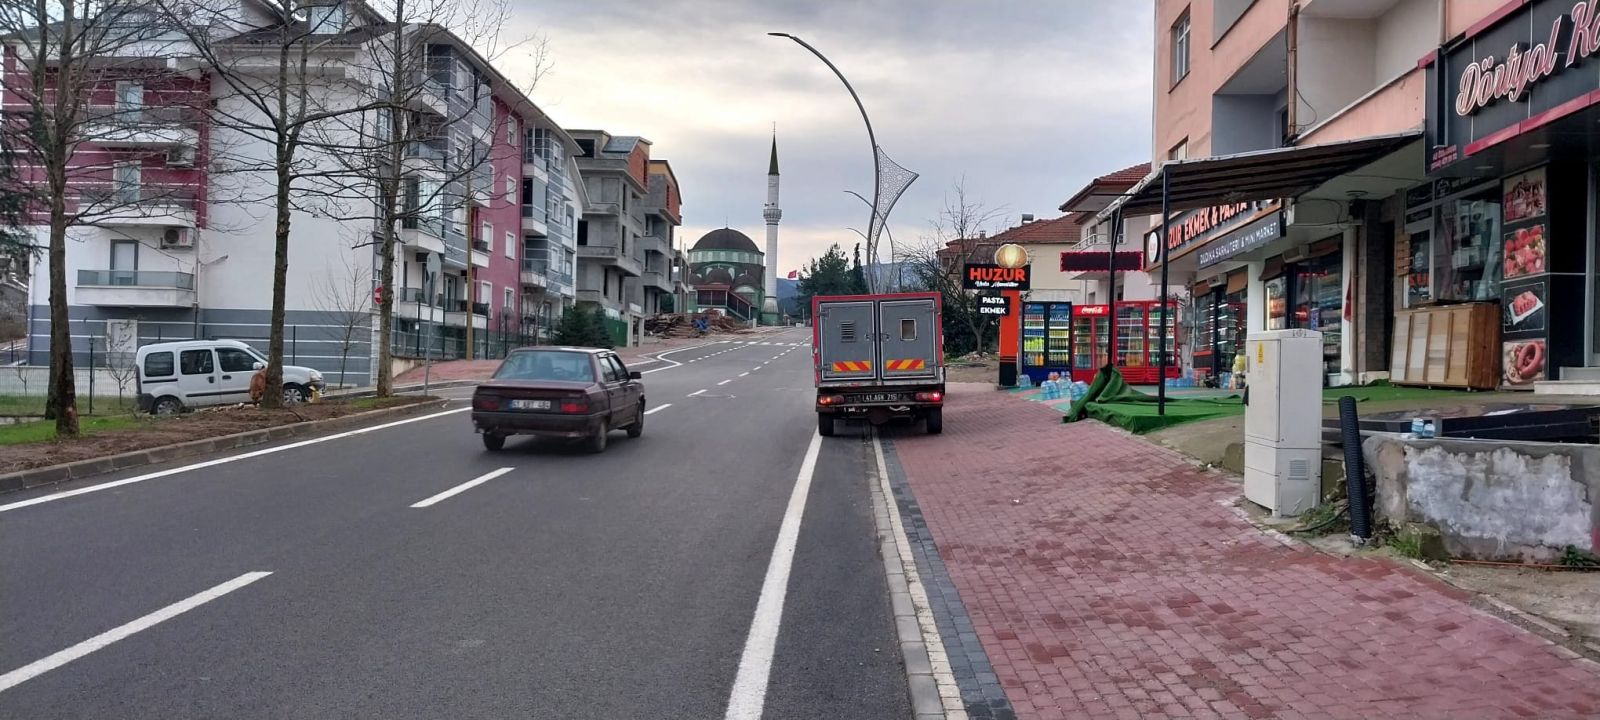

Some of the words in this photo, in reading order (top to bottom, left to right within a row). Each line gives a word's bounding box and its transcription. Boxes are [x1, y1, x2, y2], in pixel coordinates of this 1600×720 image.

[1456, 15, 1562, 116] Dörtyol
[1184, 206, 1210, 241] EKMEK
[1211, 205, 1218, 226] &
[1256, 222, 1277, 240] MARKET
[969, 267, 1026, 281] HUZUR
[980, 307, 1006, 315] EKMEK
